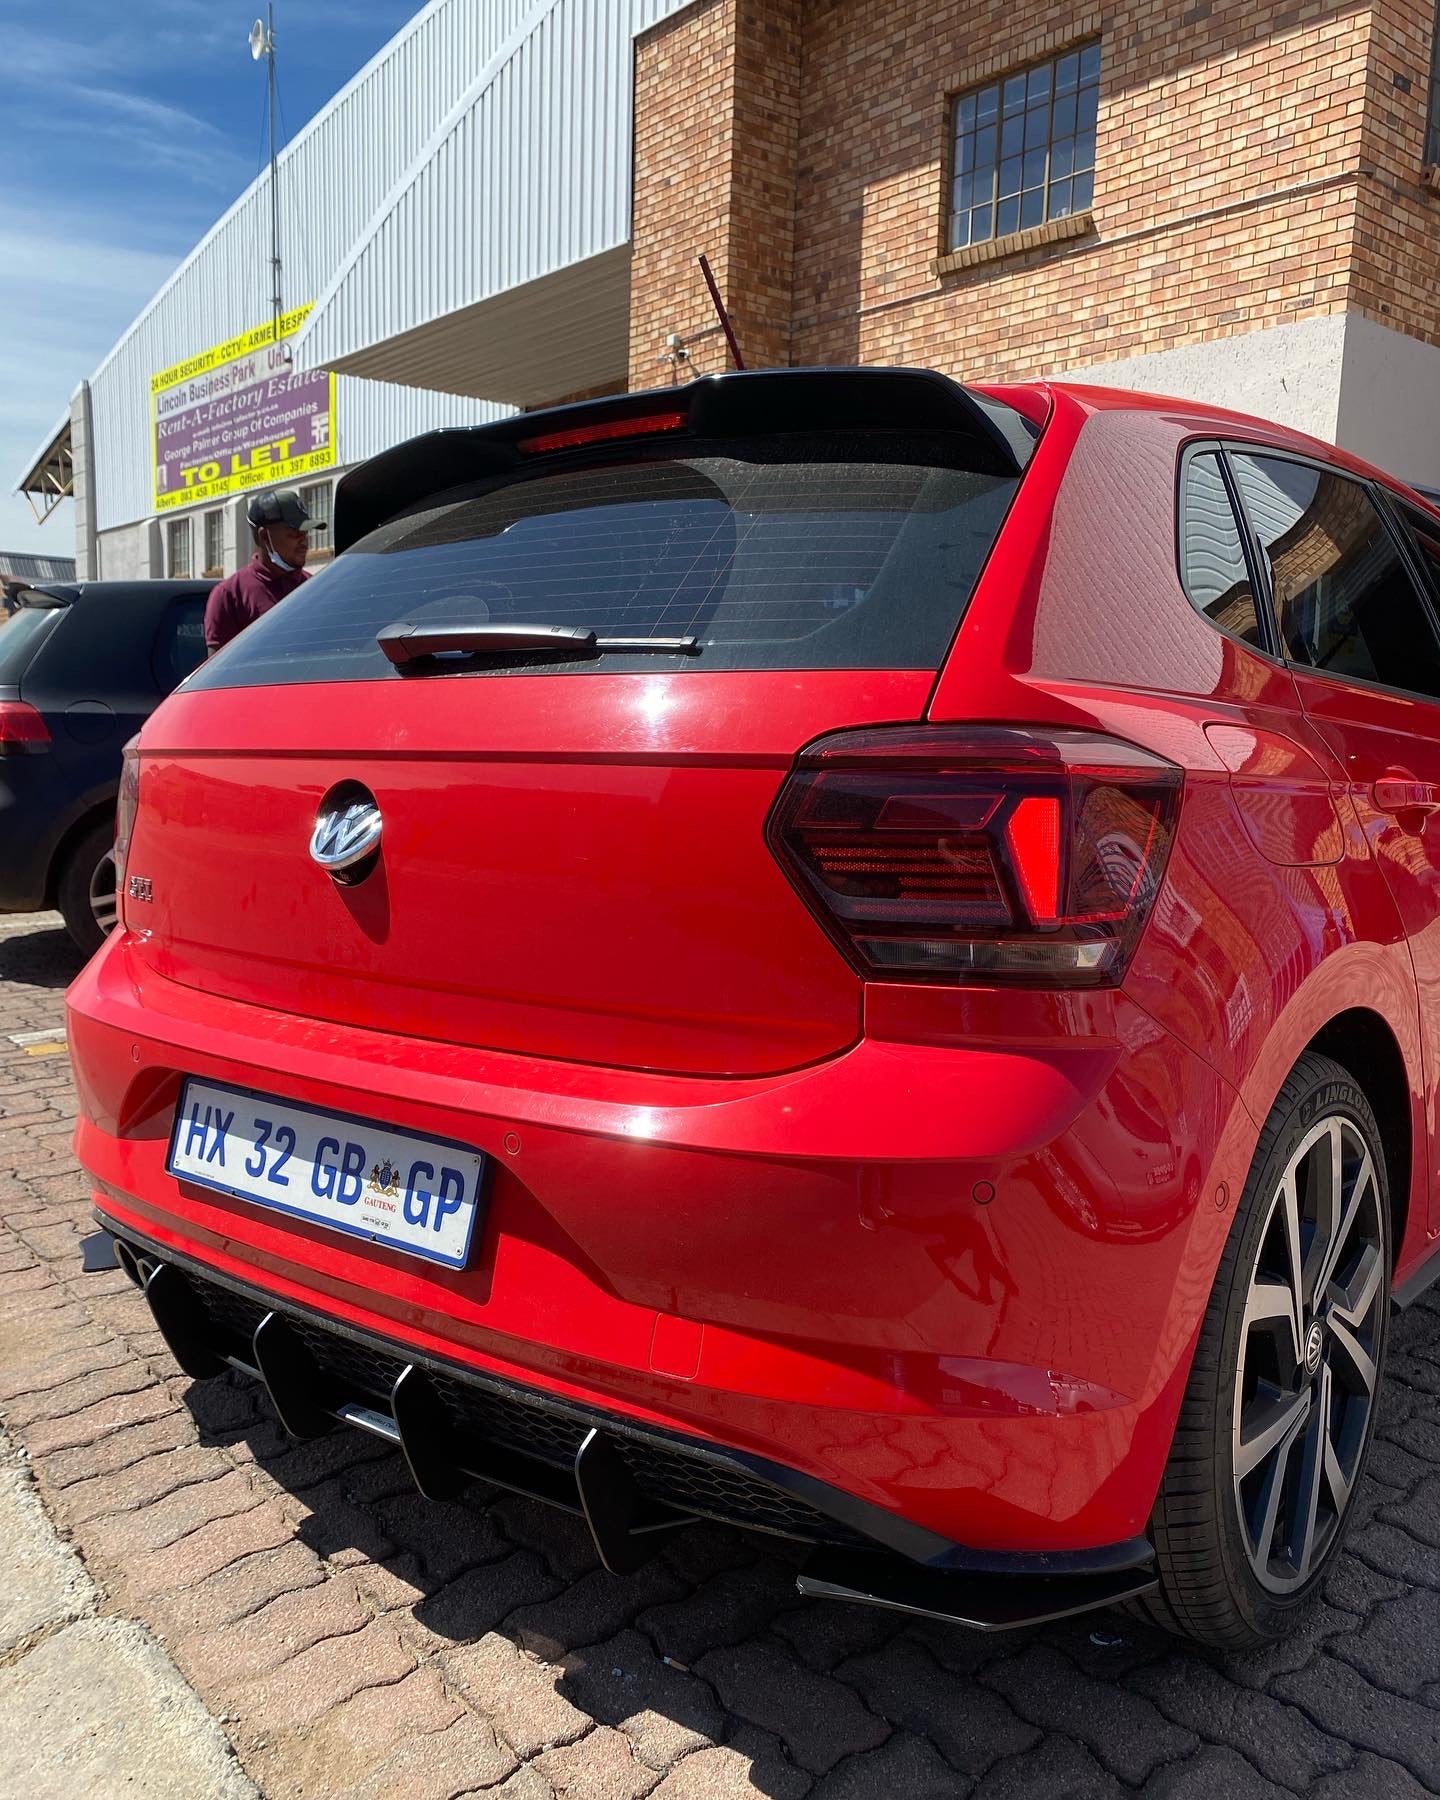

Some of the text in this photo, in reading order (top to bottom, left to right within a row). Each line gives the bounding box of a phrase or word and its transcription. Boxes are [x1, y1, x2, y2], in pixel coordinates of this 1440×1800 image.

[160, 370, 178, 386] HOUR
[180, 352, 214, 378] SECURITY
[220, 339, 241, 359] CCTV
[248, 326, 275, 347] ARME
[158, 389, 191, 415] Lincoln
[189, 373, 230, 400] Business
[232, 360, 256, 385] Park
[158, 388, 263, 439] Rent-A-Factory
[268, 369, 328, 398] Estates
[164, 445, 191, 462] George
[192, 435, 220, 454] Palmer
[222, 426, 249, 443] Group
[250, 418, 262, 432] Of
[263, 402, 318, 428] Companies
[180, 436, 296, 488] TO LET
[270, 464, 284, 478] 011
[289, 458, 303, 473] 397
[185, 1102, 464, 1232] HX 32 GB GP
[364, 1196, 396, 1214] GAUTENG
